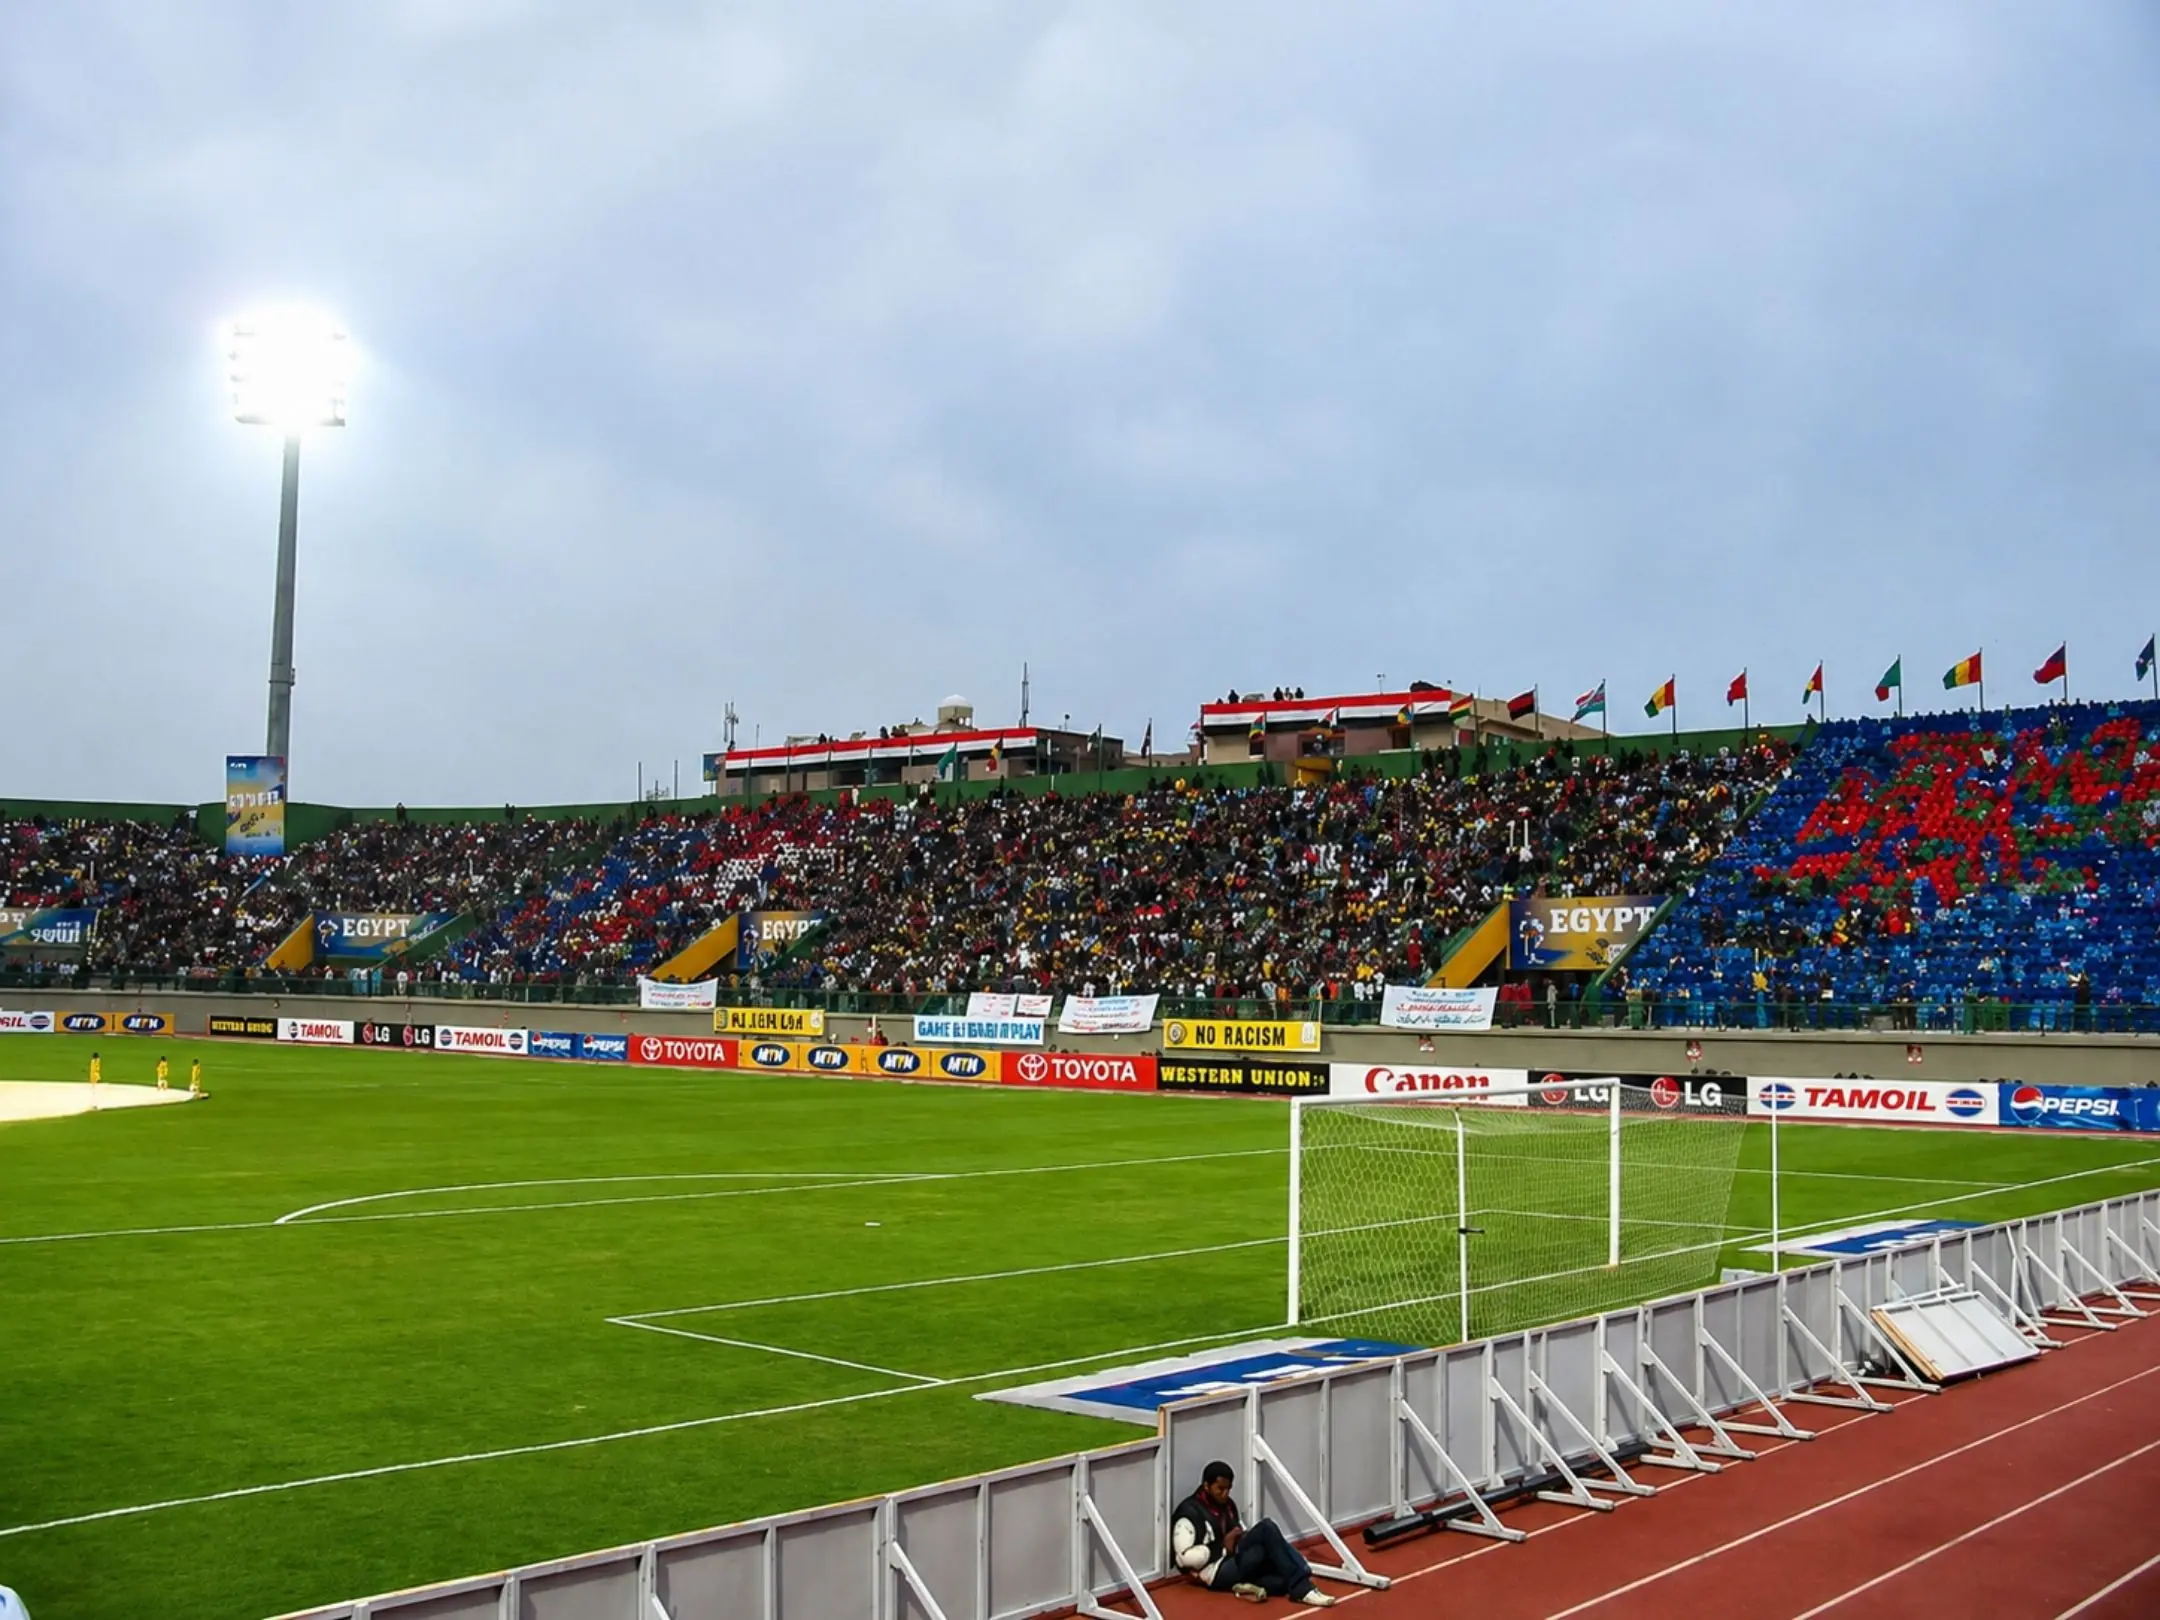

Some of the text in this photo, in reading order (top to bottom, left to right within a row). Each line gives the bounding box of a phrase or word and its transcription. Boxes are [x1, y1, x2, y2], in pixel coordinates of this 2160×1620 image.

[342, 918, 411, 937] EGYPT
[1549, 906, 1656, 932] EGYPT
[301, 1024, 343, 1039] TAMOIL
[375, 1026, 390, 1042] LG
[414, 1028, 430, 1044] LG
[454, 1032, 506, 1047] TAMOIL
[1196, 1025, 1286, 1046] NO RACISM
[664, 1041, 725, 1061] TOYOTA
[884, 1054, 914, 1069] MTN
[948, 1057, 979, 1073] MTN
[1051, 1058, 1137, 1082] TOYOTA
[1160, 1066, 1243, 1084] WESTERN
[1365, 1067, 1490, 1100] Canon
[1684, 1081, 1722, 1107] LG
[1804, 1087, 1936, 1111] TAMOIL
[2043, 1097, 2119, 1116] PEPSI
